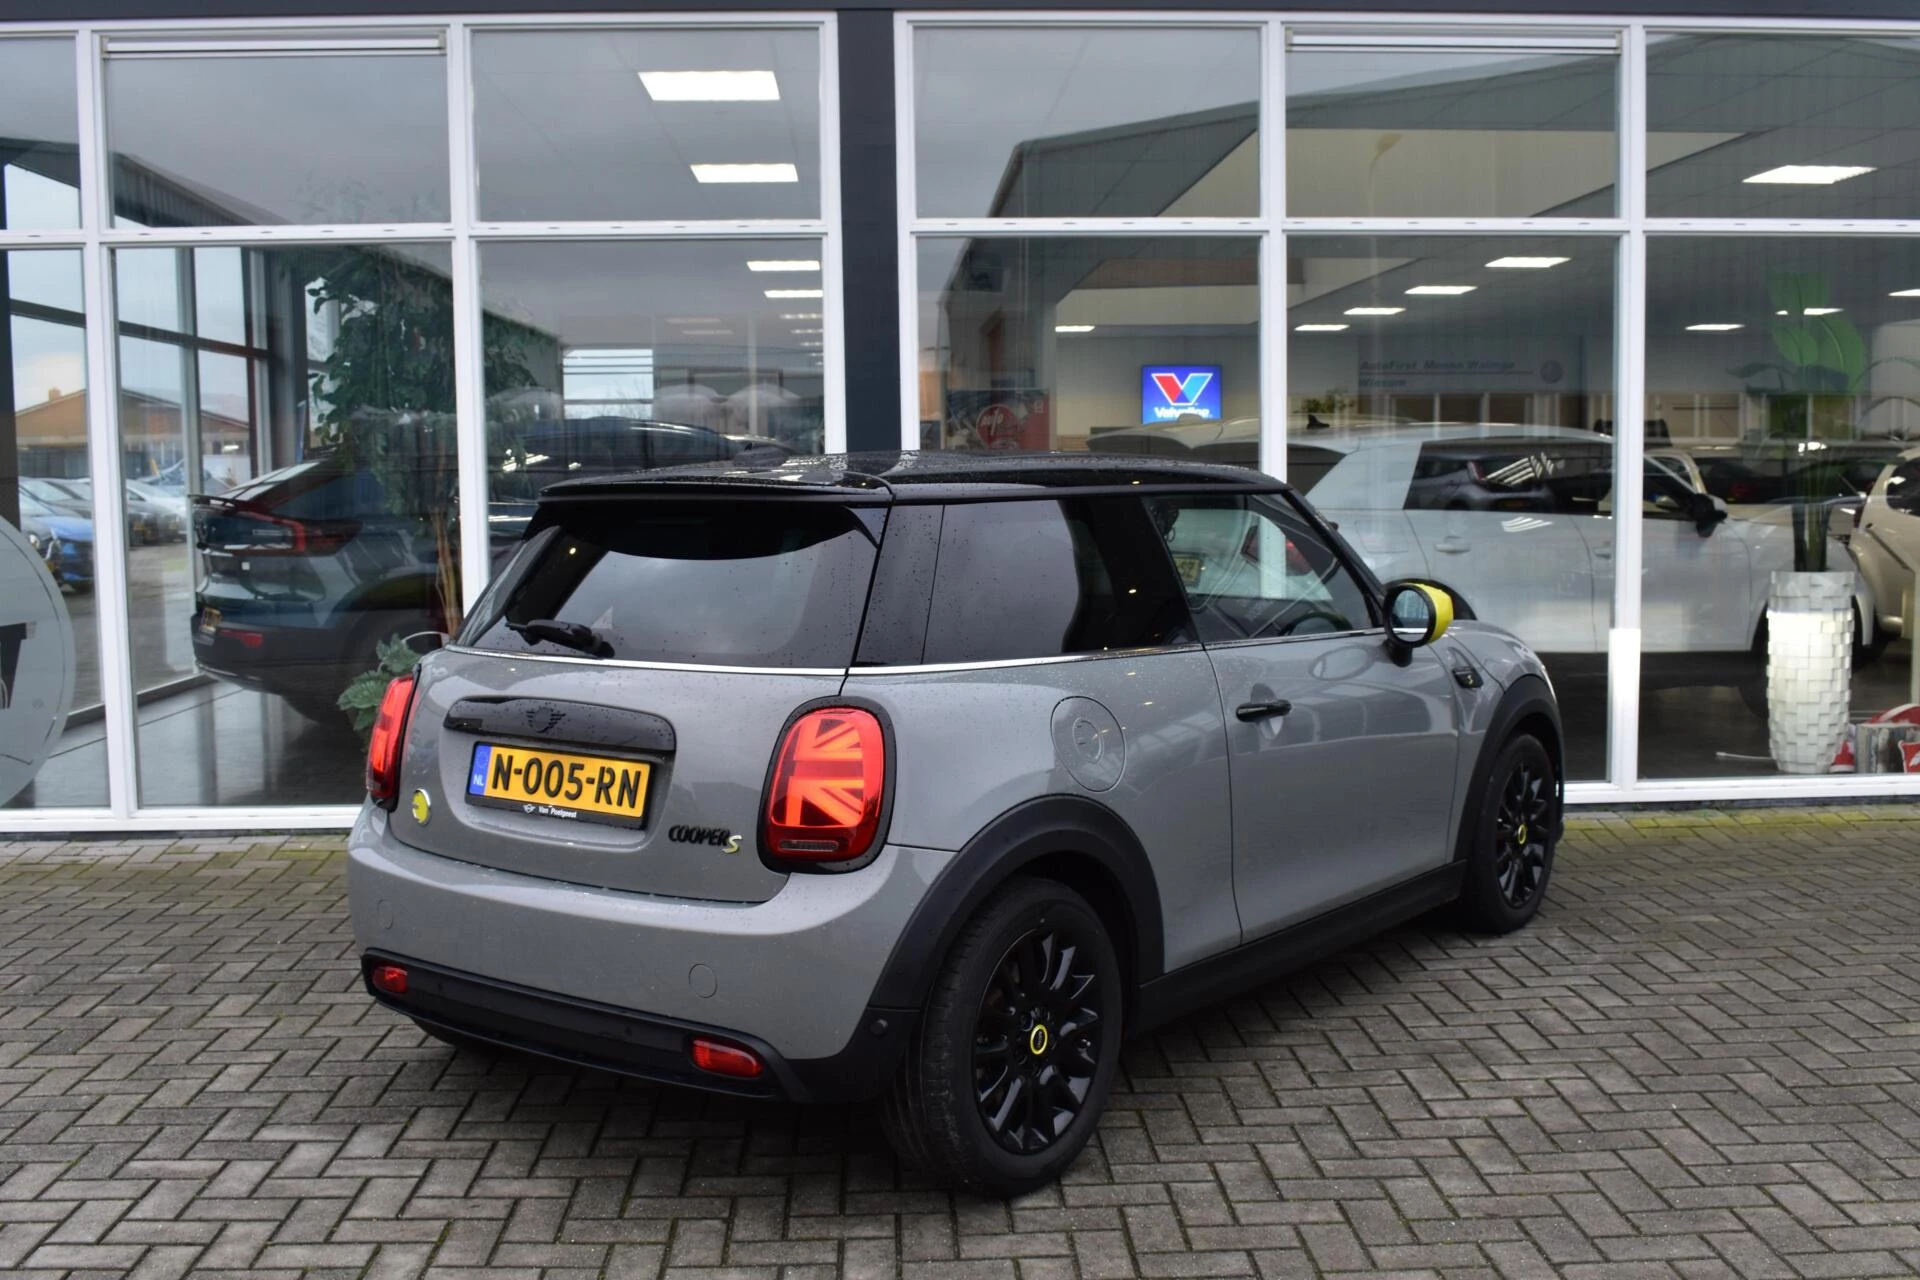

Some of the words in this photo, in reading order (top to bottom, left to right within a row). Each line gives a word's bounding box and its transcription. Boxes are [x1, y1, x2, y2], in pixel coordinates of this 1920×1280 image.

[473, 774, 484, 786] NL
[492, 753, 641, 808] N-005-RN
[668, 824, 731, 847] COOPER
[722, 834, 743, 854] S
